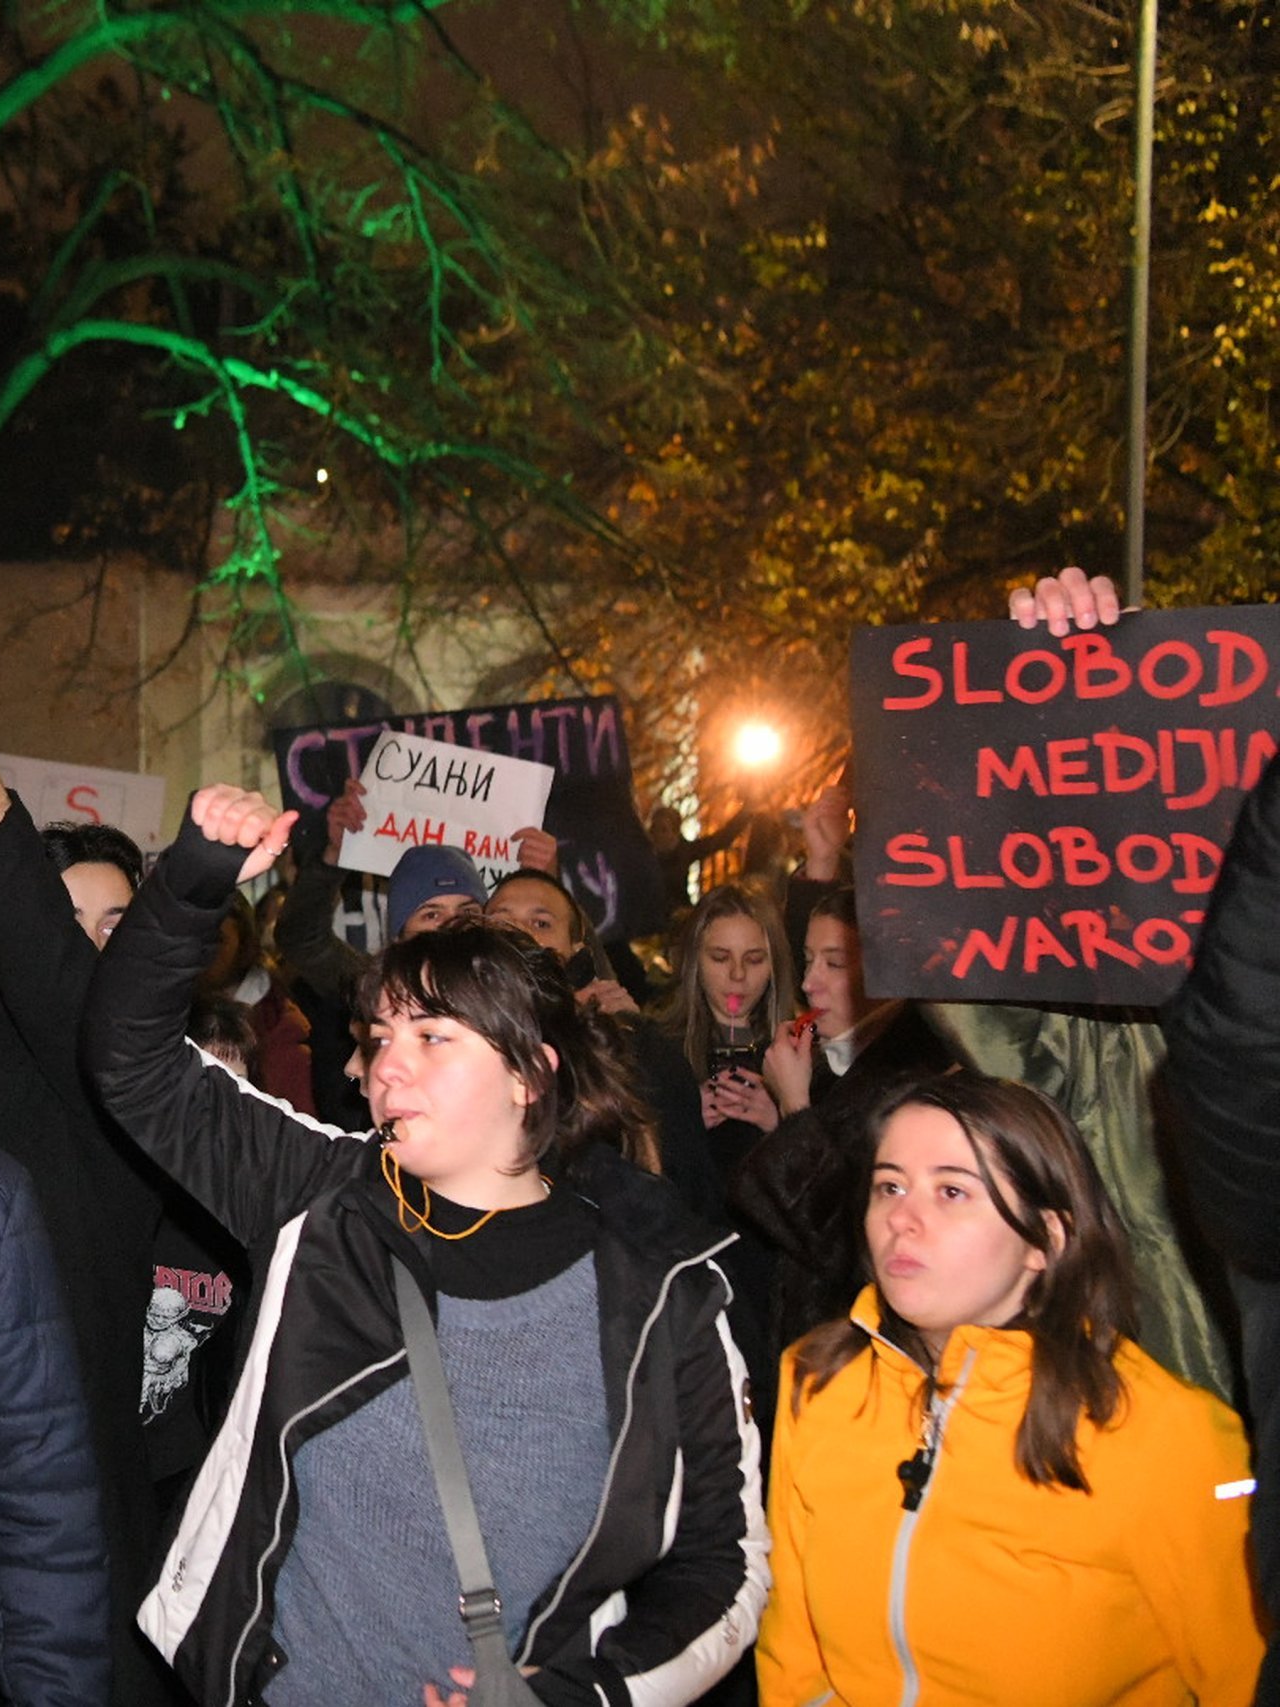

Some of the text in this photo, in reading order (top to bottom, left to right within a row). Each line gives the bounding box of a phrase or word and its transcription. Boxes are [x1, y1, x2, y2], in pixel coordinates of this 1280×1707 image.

[883, 630, 1280, 711] SLOBOD
[375, 740, 497, 802] СУДЊИ
[374, 812, 510, 862] ДАН ВАМ
[952, 909, 1206, 980] NARO
[153, 1264, 233, 1316] ATOR
